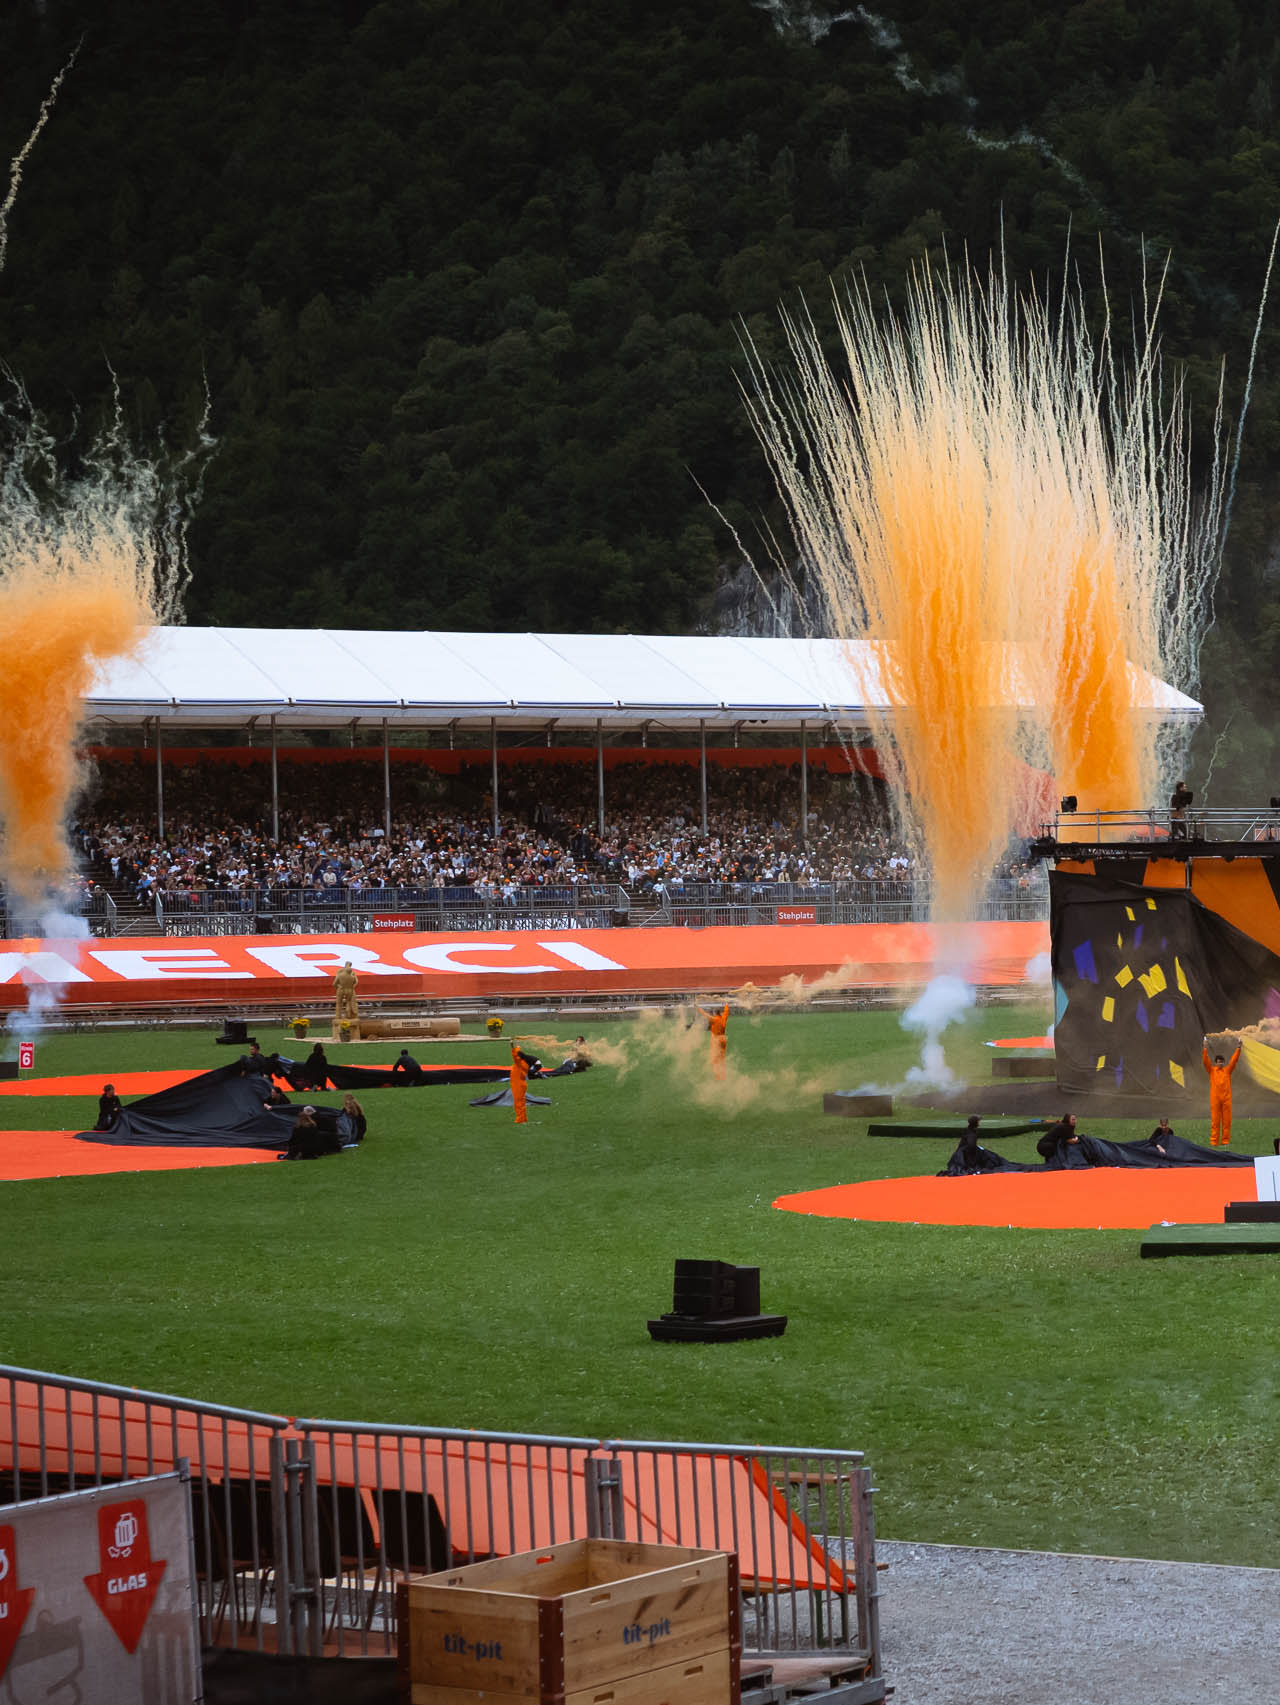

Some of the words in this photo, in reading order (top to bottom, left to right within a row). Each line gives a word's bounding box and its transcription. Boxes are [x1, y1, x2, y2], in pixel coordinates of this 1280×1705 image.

[374, 919, 414, 929] Stehplatz
[778, 911, 815, 921] Stehplatz
[22, 1052, 31, 1066] 6
[107, 1572, 147, 1595] GLAS
[623, 1616, 671, 1648] tit-pit
[443, 1631, 503, 1661] tit-pit
